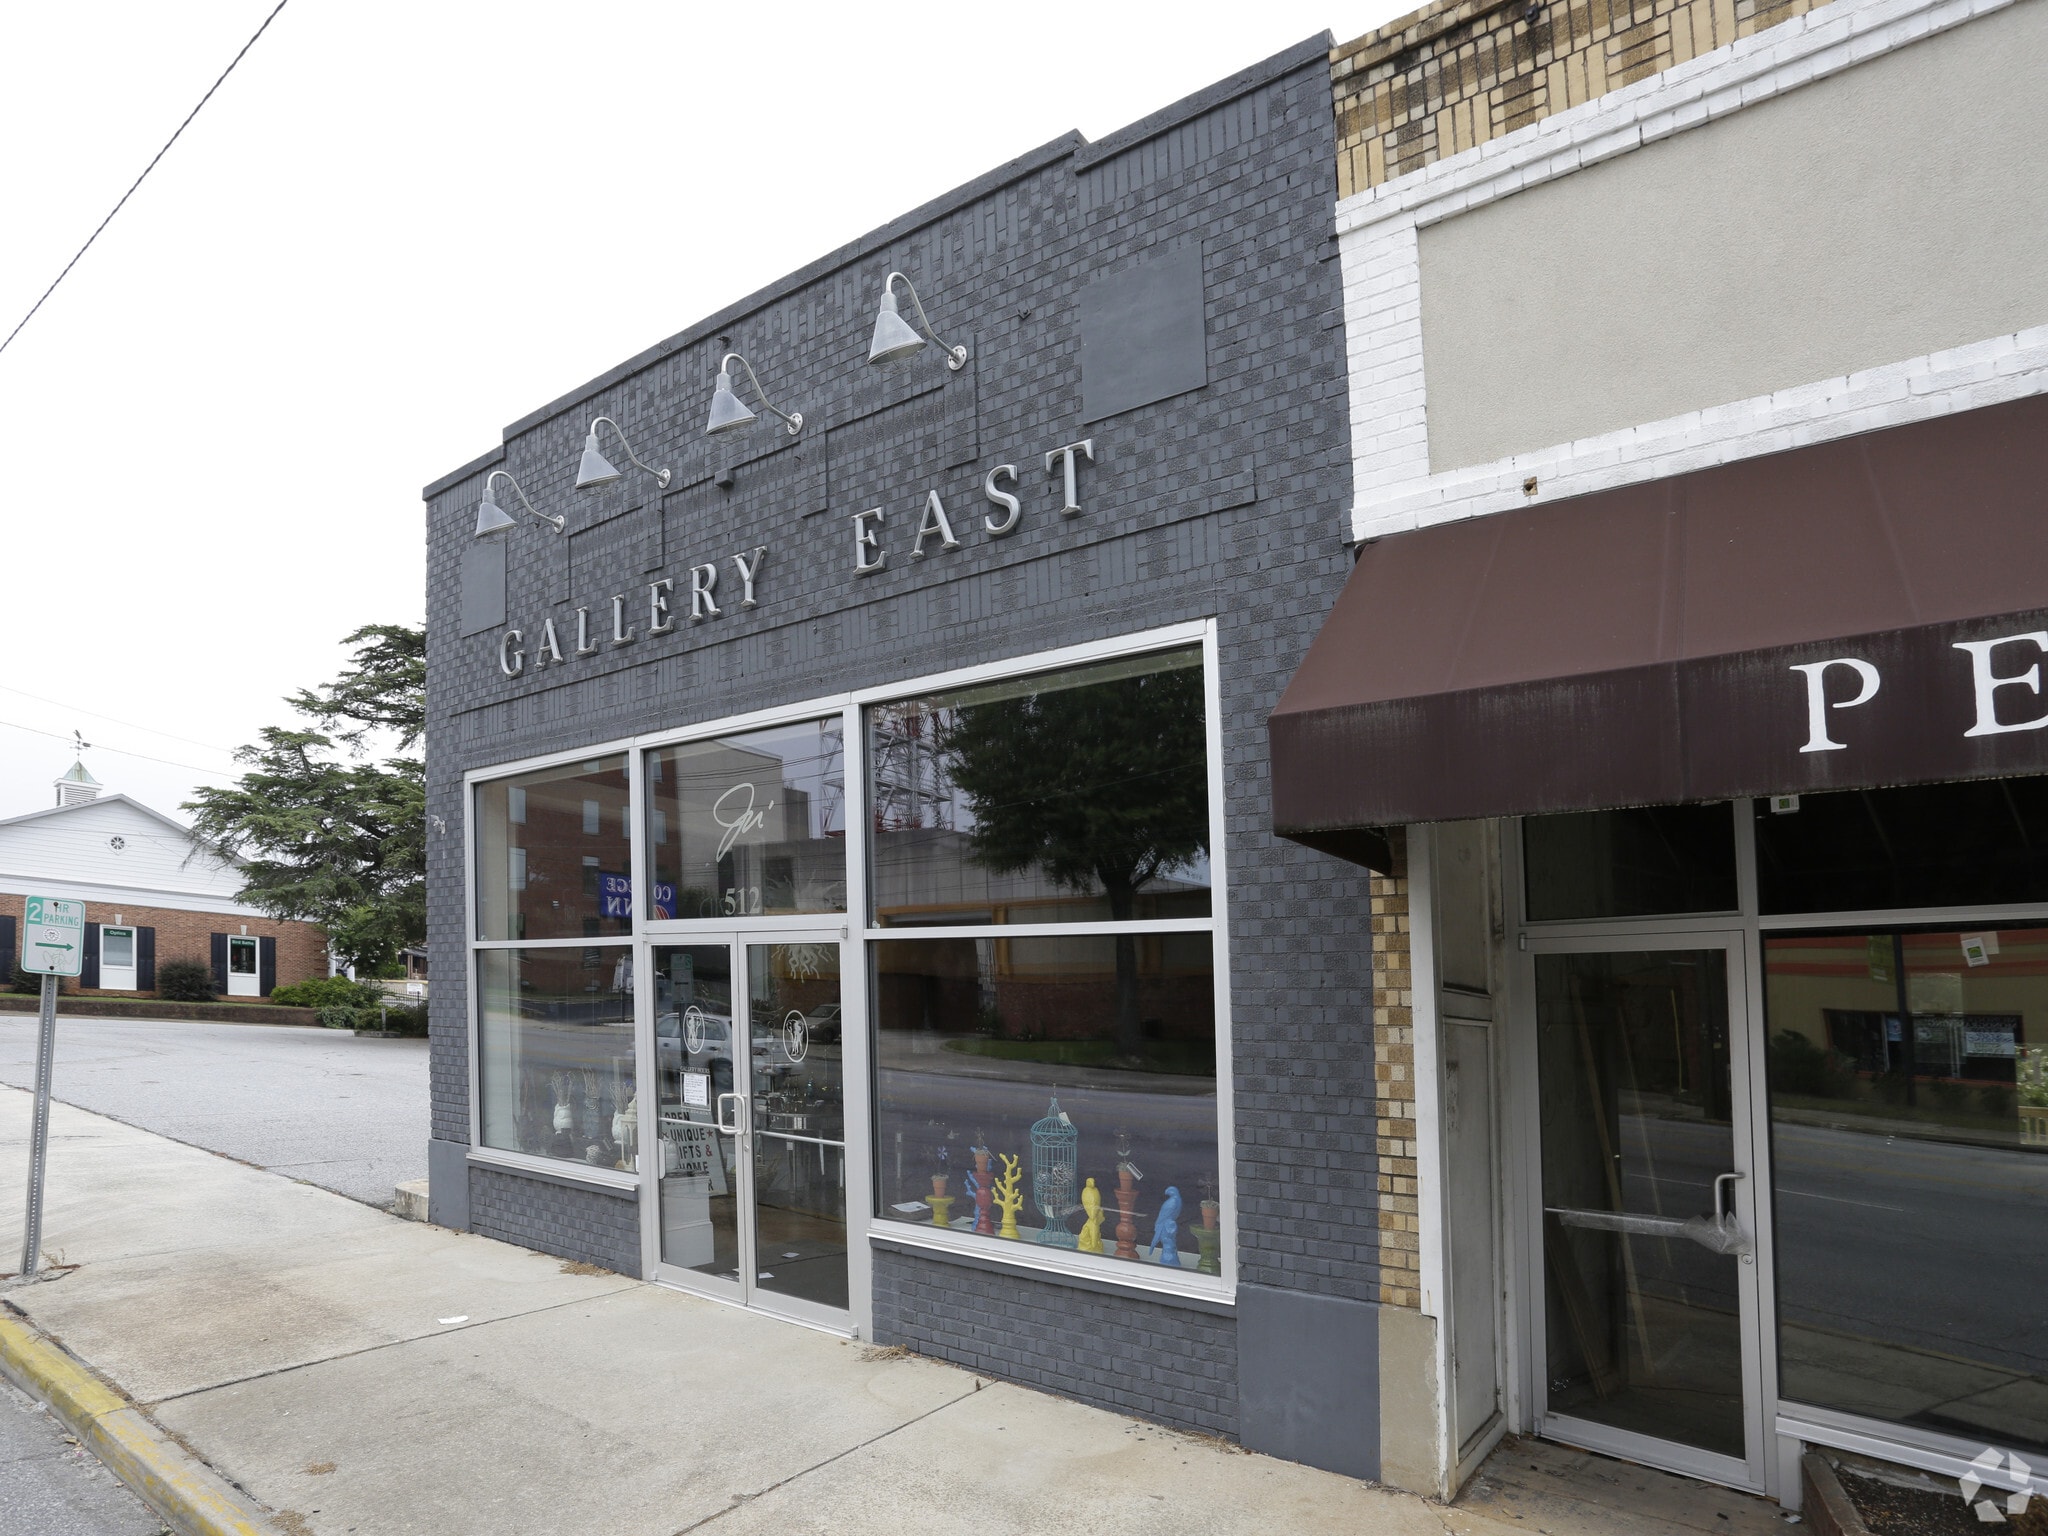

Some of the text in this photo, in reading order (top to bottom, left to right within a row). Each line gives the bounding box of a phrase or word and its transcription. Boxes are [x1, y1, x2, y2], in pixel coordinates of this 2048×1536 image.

[499, 438, 1095, 679] GALLERY EAST
[724, 886, 761, 916] 512
[28, 902, 42, 922] 2
[43, 913, 79, 927] PARKING
[664, 1111, 691, 1126] OPEN
[670, 1127, 707, 1142] UNIQUE
[678, 1144, 702, 1160] IFTS
